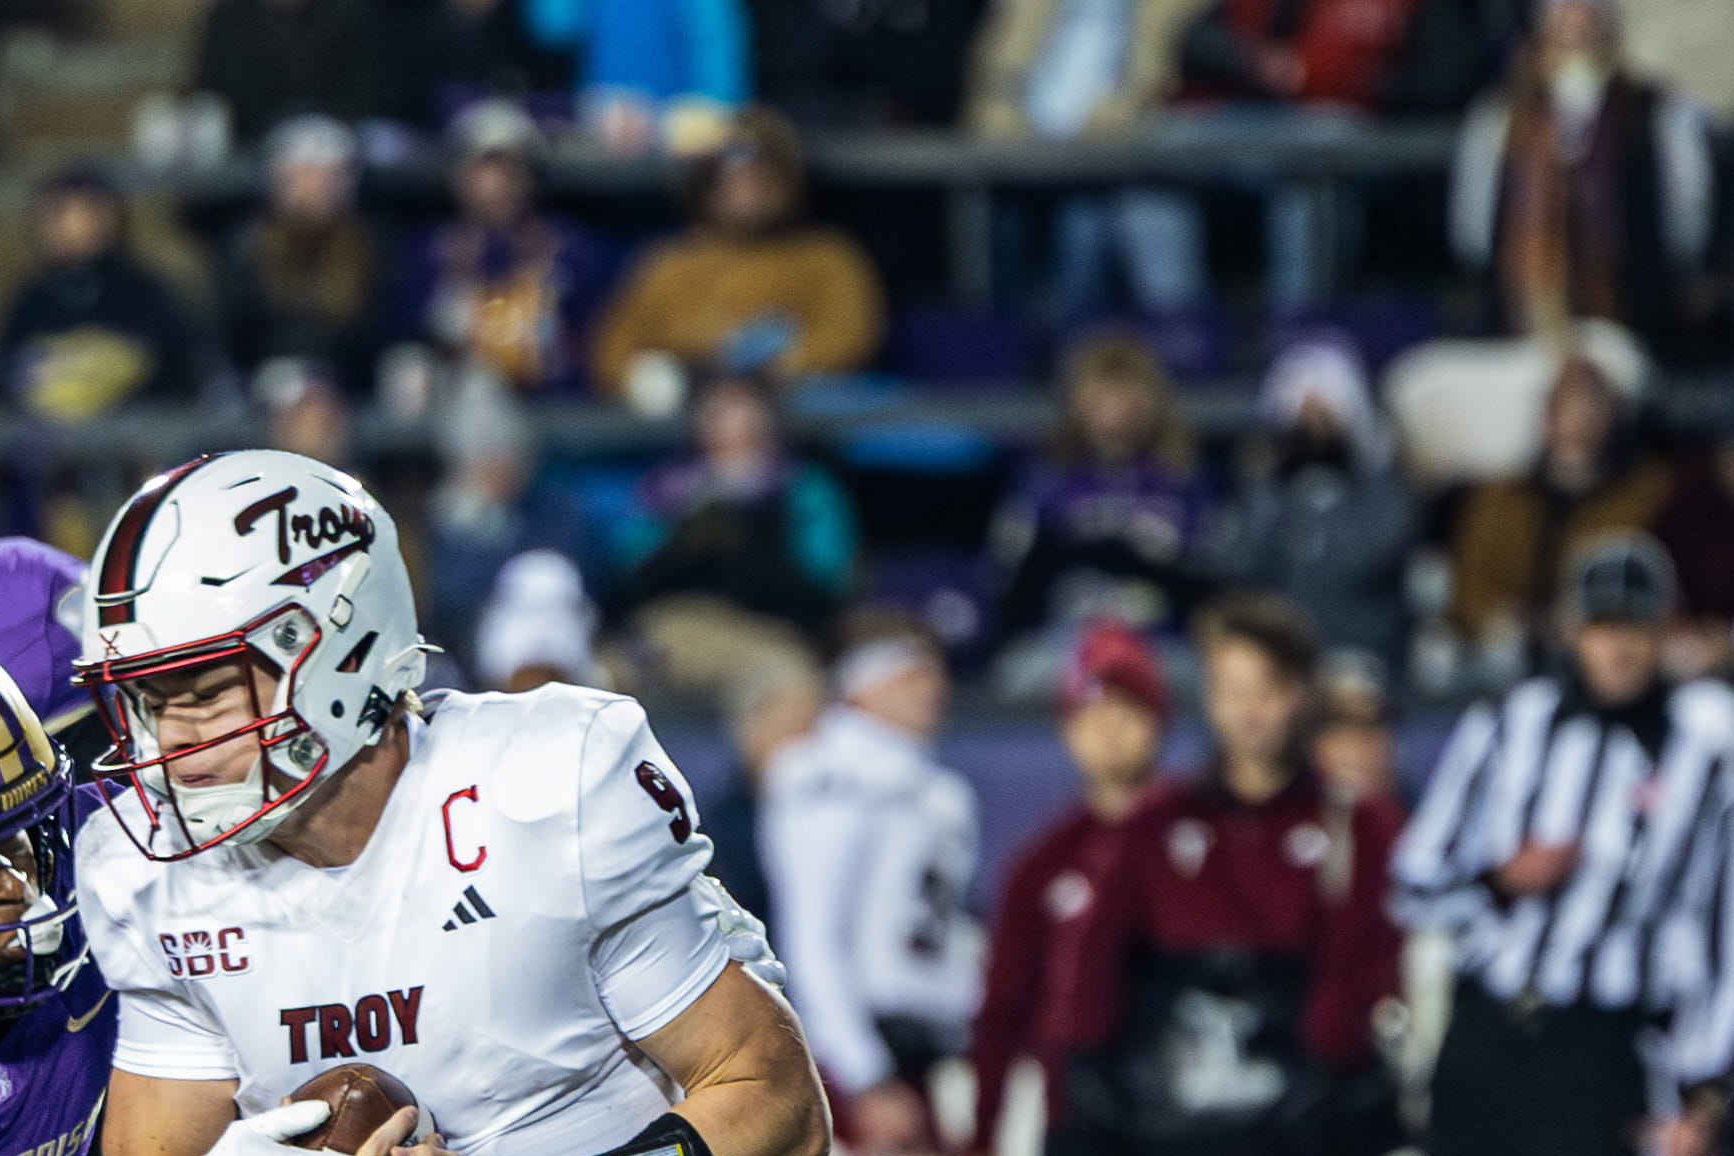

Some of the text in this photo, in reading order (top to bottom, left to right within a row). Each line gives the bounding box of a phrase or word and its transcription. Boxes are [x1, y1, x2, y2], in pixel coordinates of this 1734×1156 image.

[234, 486, 375, 565] Troy
[441, 784, 487, 873] C
[634, 760, 692, 845] 9
[159, 927, 250, 978] SBC
[279, 985, 425, 1064] TROY
